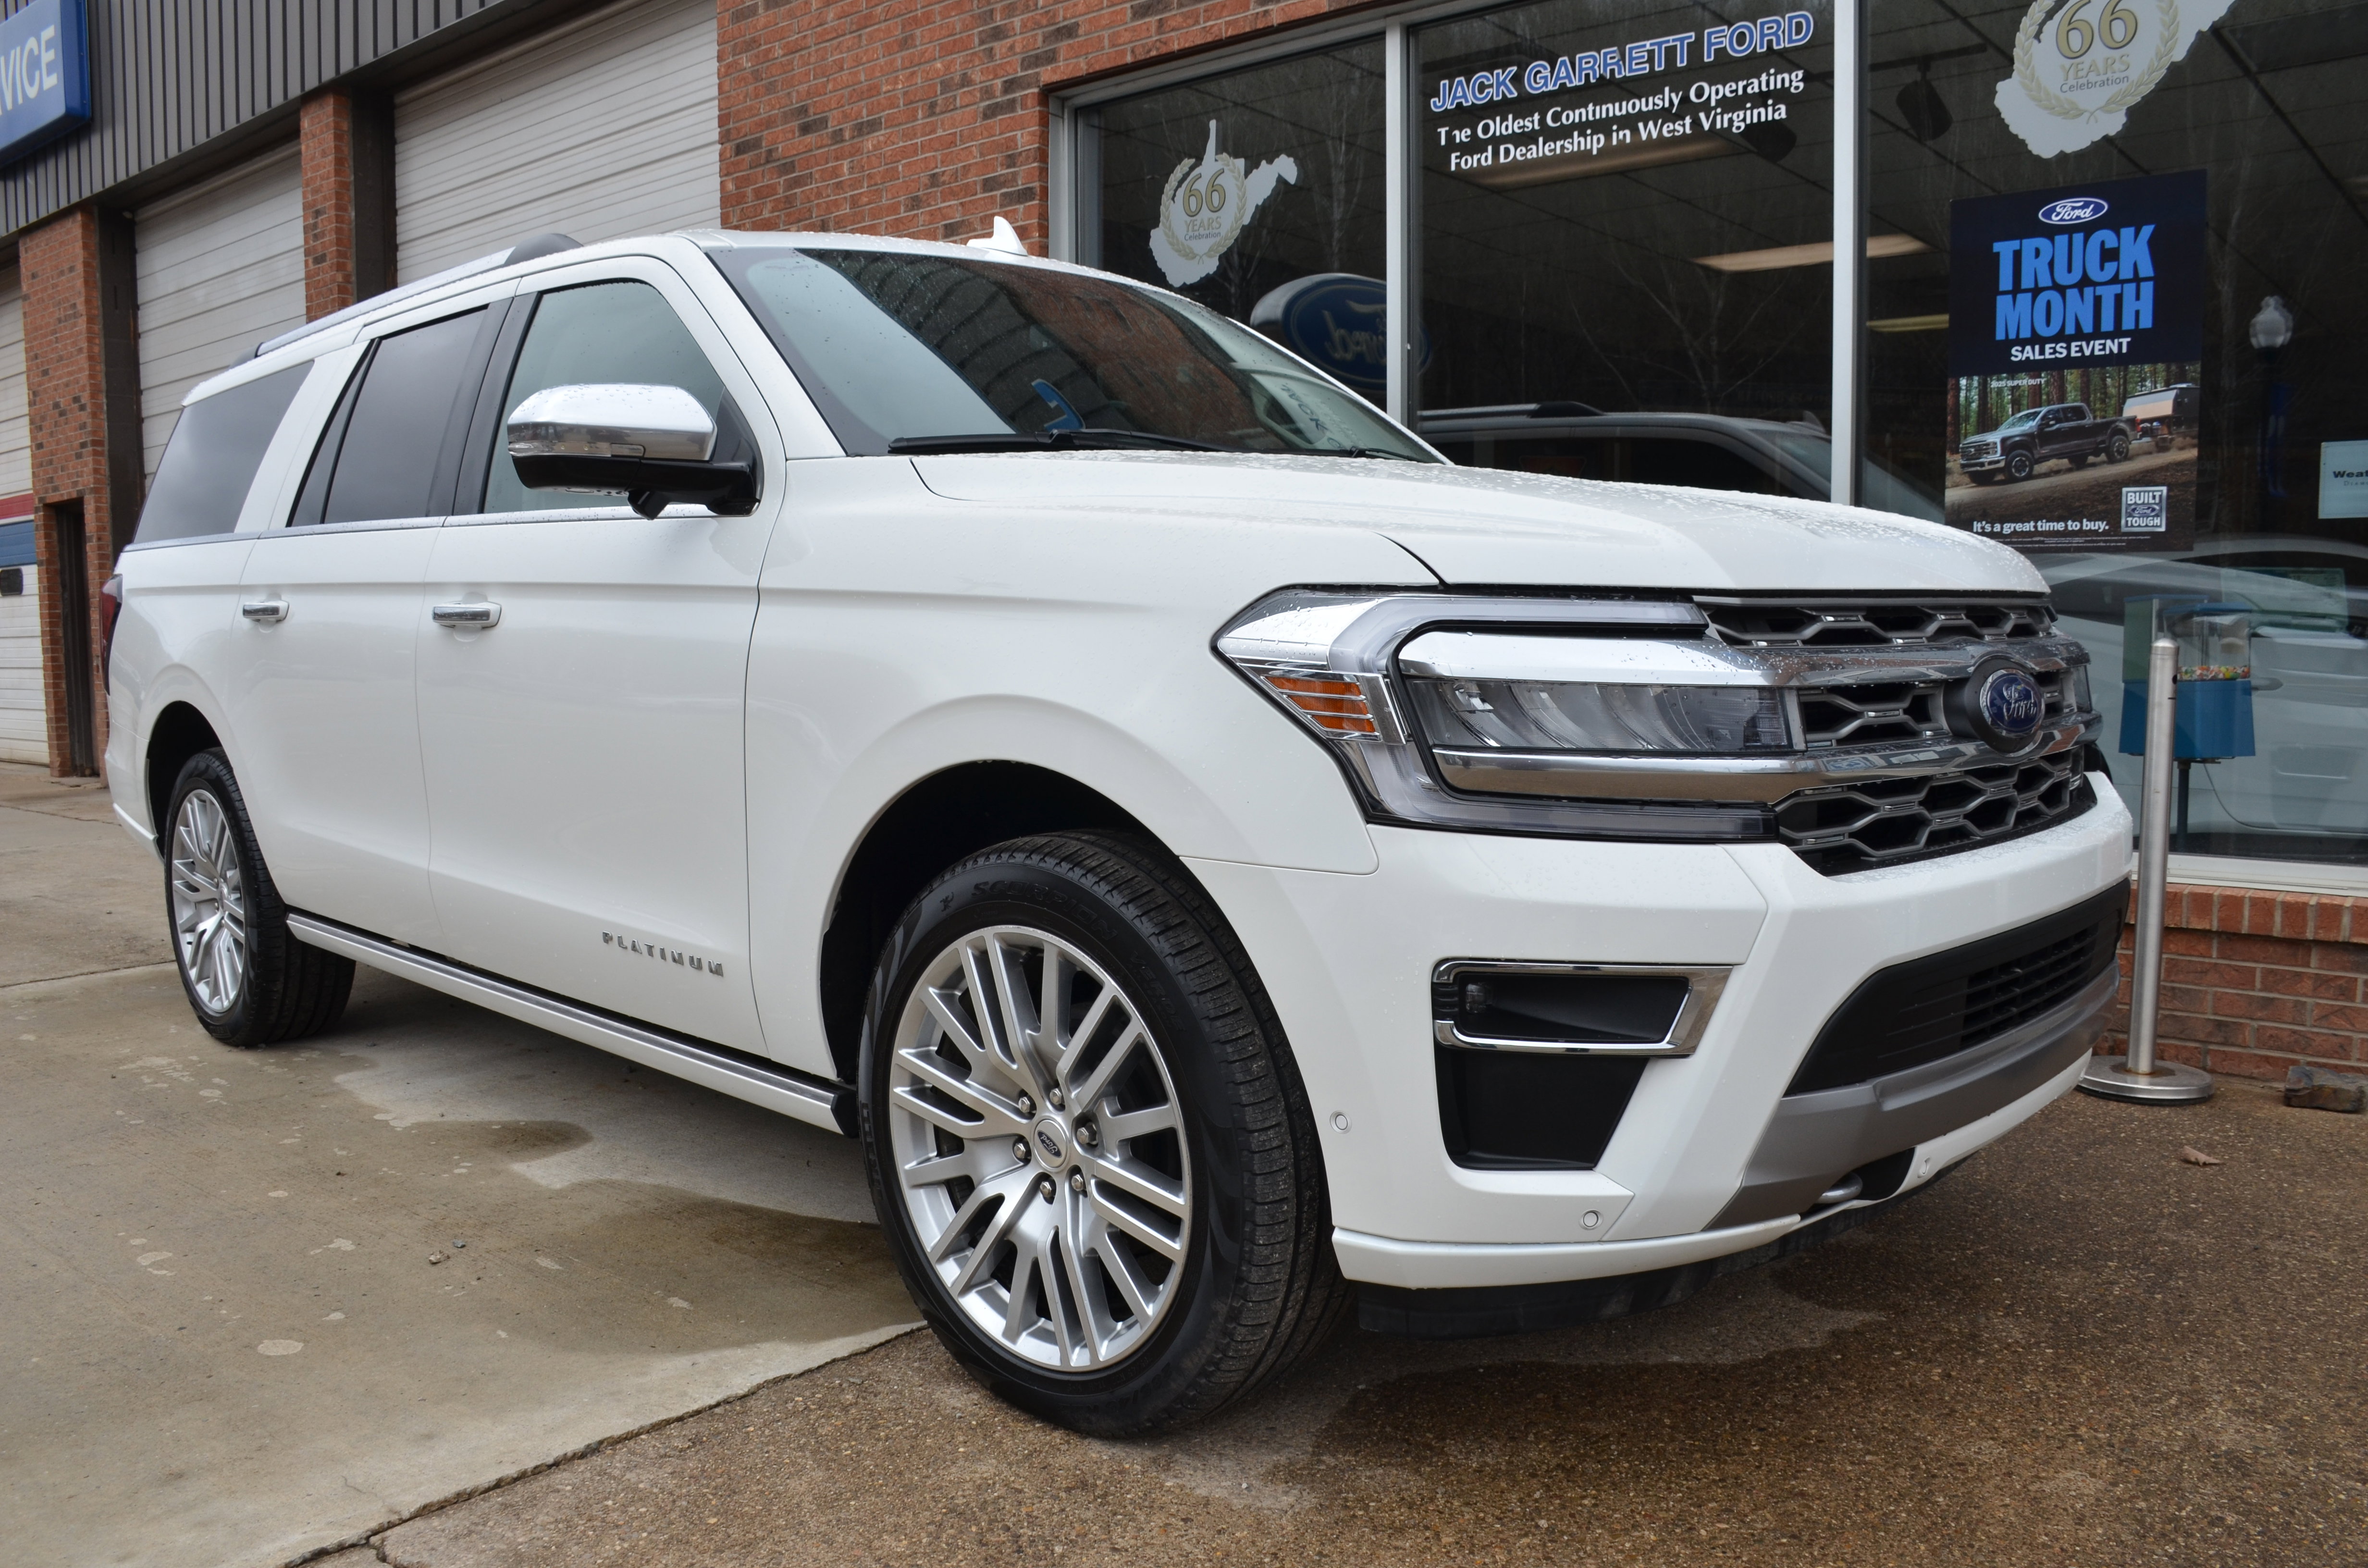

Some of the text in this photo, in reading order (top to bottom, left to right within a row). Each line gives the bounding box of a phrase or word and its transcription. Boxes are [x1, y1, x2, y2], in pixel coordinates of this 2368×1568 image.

[2056, 0, 2138, 59] 66
[0, 25, 58, 115] VICE
[1431, 11, 1813, 111] JACK GARRETT FORD
[2060, 53, 2130, 82] YEARS
[2060, 74, 2130, 93] Celebration
[1477, 112, 1540, 139] Oldest
[1546, 86, 1682, 127] Continuously
[1690, 68, 1804, 106] Operating
[1450, 99, 1787, 172] Ford Dealership in West Virginia
[1183, 168, 1226, 217] 66
[1184, 216, 1221, 233] YEARS
[2051, 201, 2095, 221] Ford
[1184, 232, 1221, 241] Celebration
[1993, 224, 2156, 291] TRUCK
[1996, 281, 2155, 341] MONTH
[2010, 337, 2132, 361] SALES EVENT
[1990, 379, 2007, 388] 2025
[2007, 377, 2028, 387] SUPER
[2127, 491, 2162, 504] BUILT
[1973, 518, 2109, 534] It's a great time to buy.
[2126, 516, 2161, 527] TOUGH
[602, 930, 724, 977] PLATINUM
